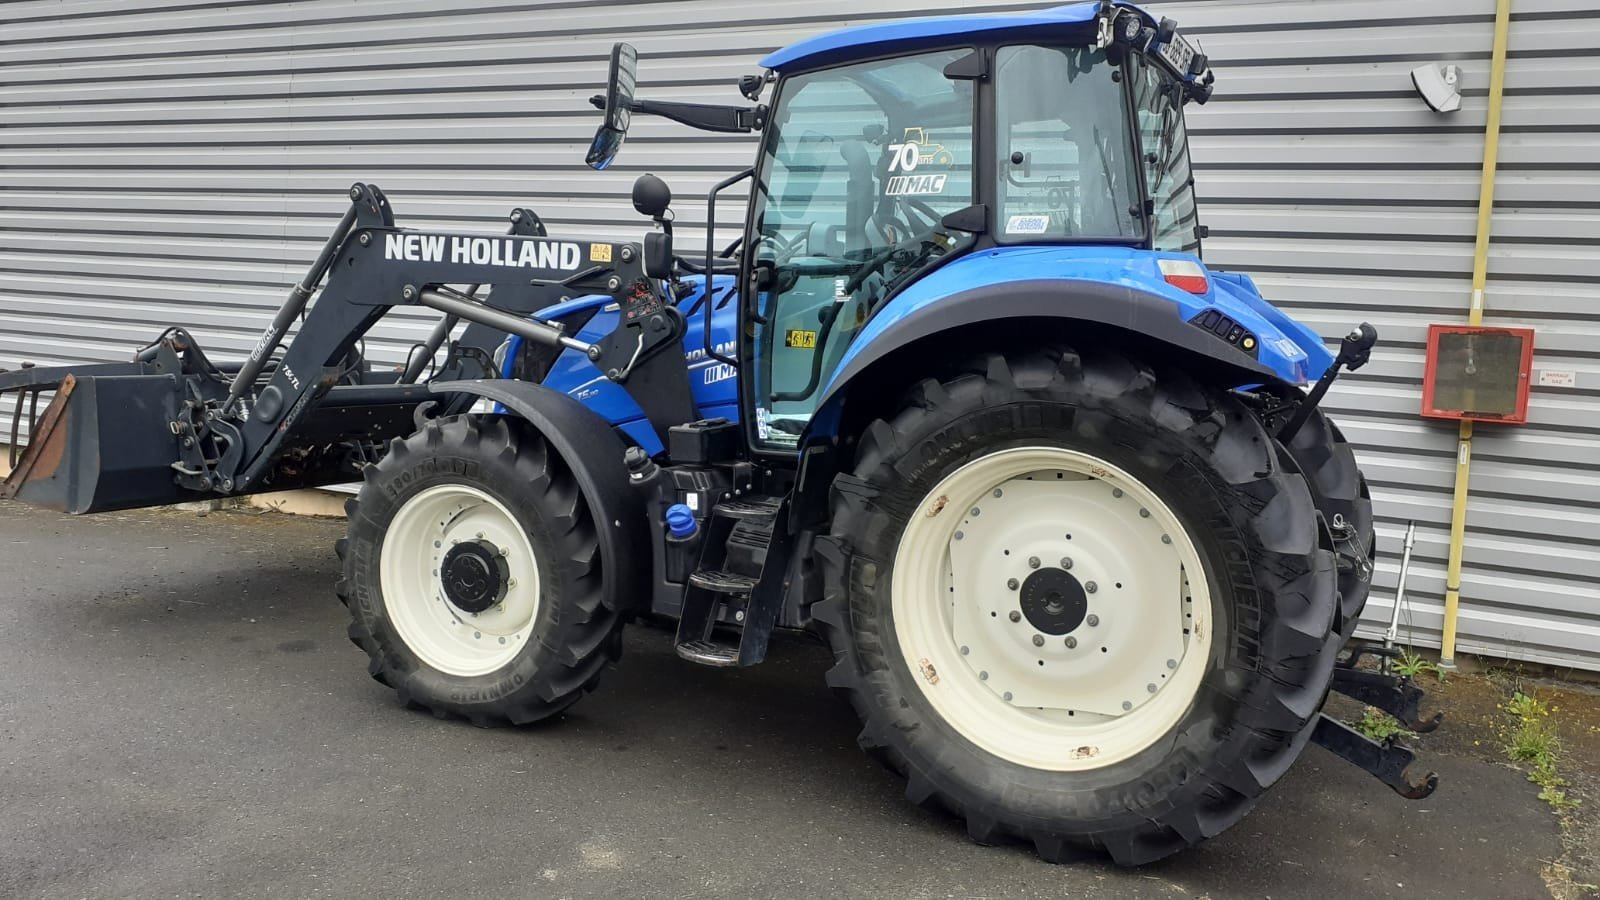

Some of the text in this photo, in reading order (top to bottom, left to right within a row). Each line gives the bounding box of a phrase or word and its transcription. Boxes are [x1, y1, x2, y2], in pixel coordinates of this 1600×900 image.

[888, 143, 919, 172] 70
[384, 234, 581, 271] NEW HOLLAND
[685, 340, 737, 361] HOLAN
